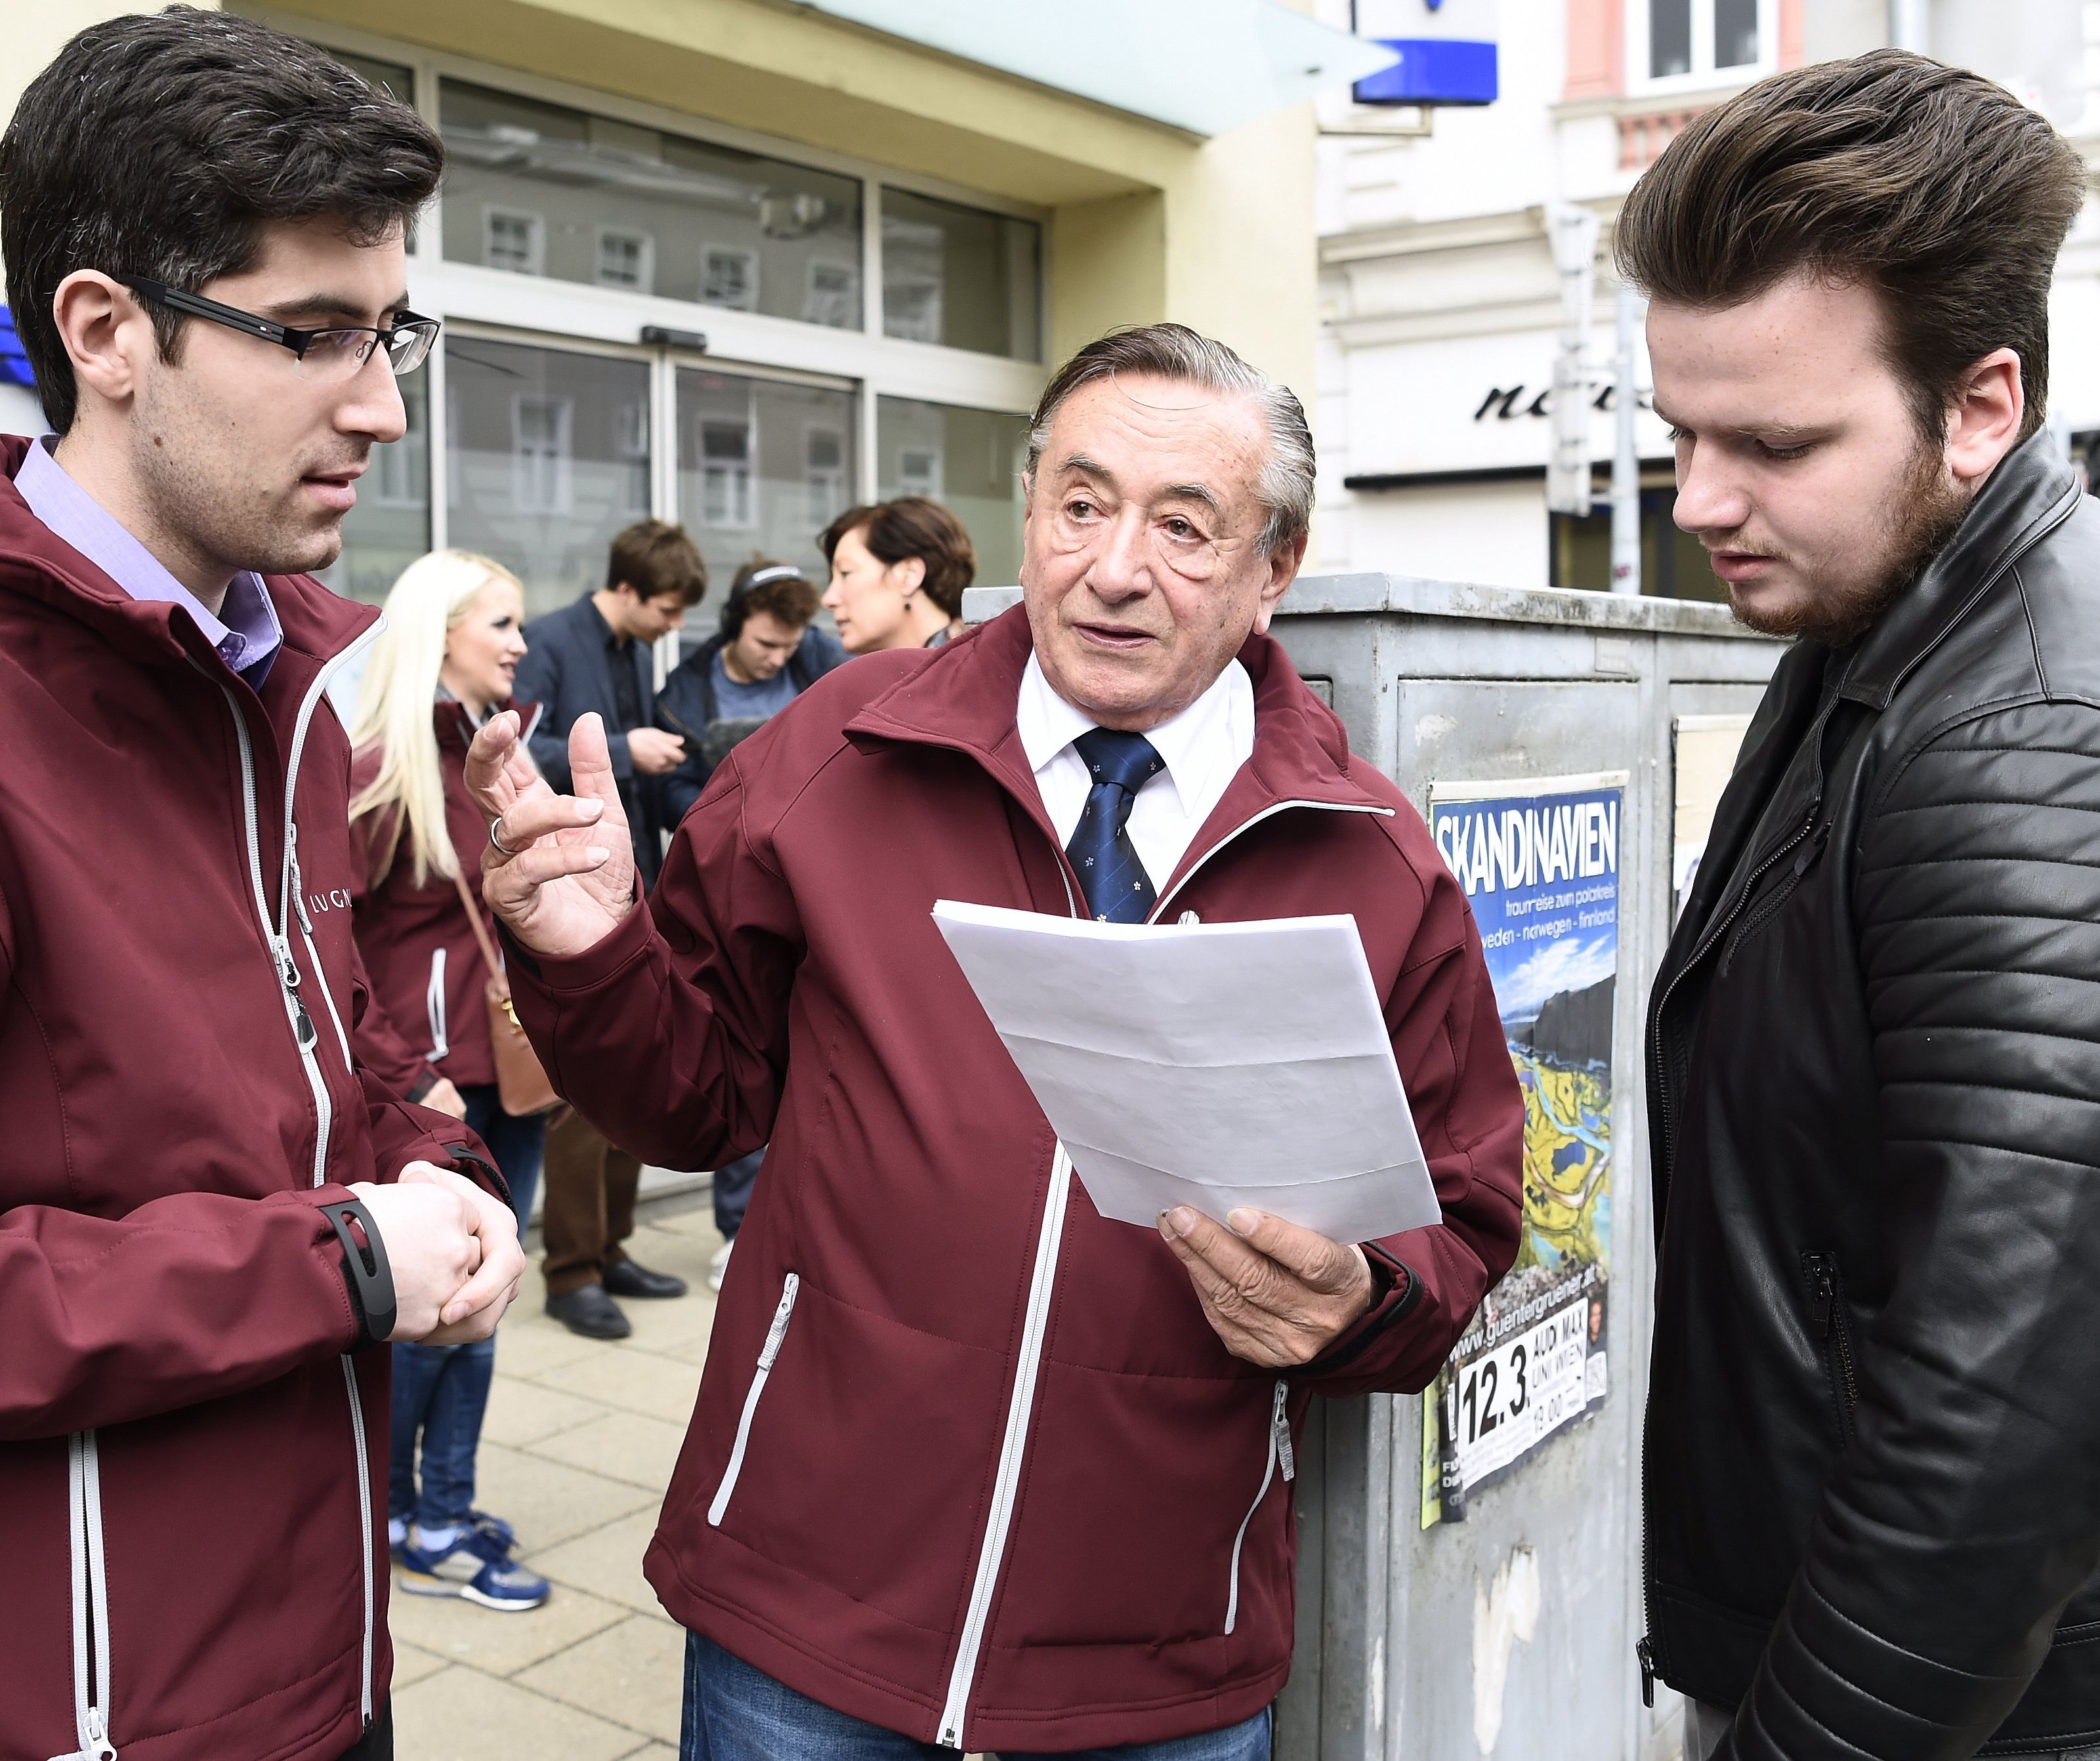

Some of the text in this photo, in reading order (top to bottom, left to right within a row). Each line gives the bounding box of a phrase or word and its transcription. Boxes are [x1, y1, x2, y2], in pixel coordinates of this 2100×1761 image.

[1437, 800, 1616, 896] SKANDINAVIEN
[1506, 894, 1555, 917] traumreise
[1555, 892, 1574, 909] zum
[1522, 917, 1572, 939] norwegen
[1579, 907, 1615, 929] finnland
